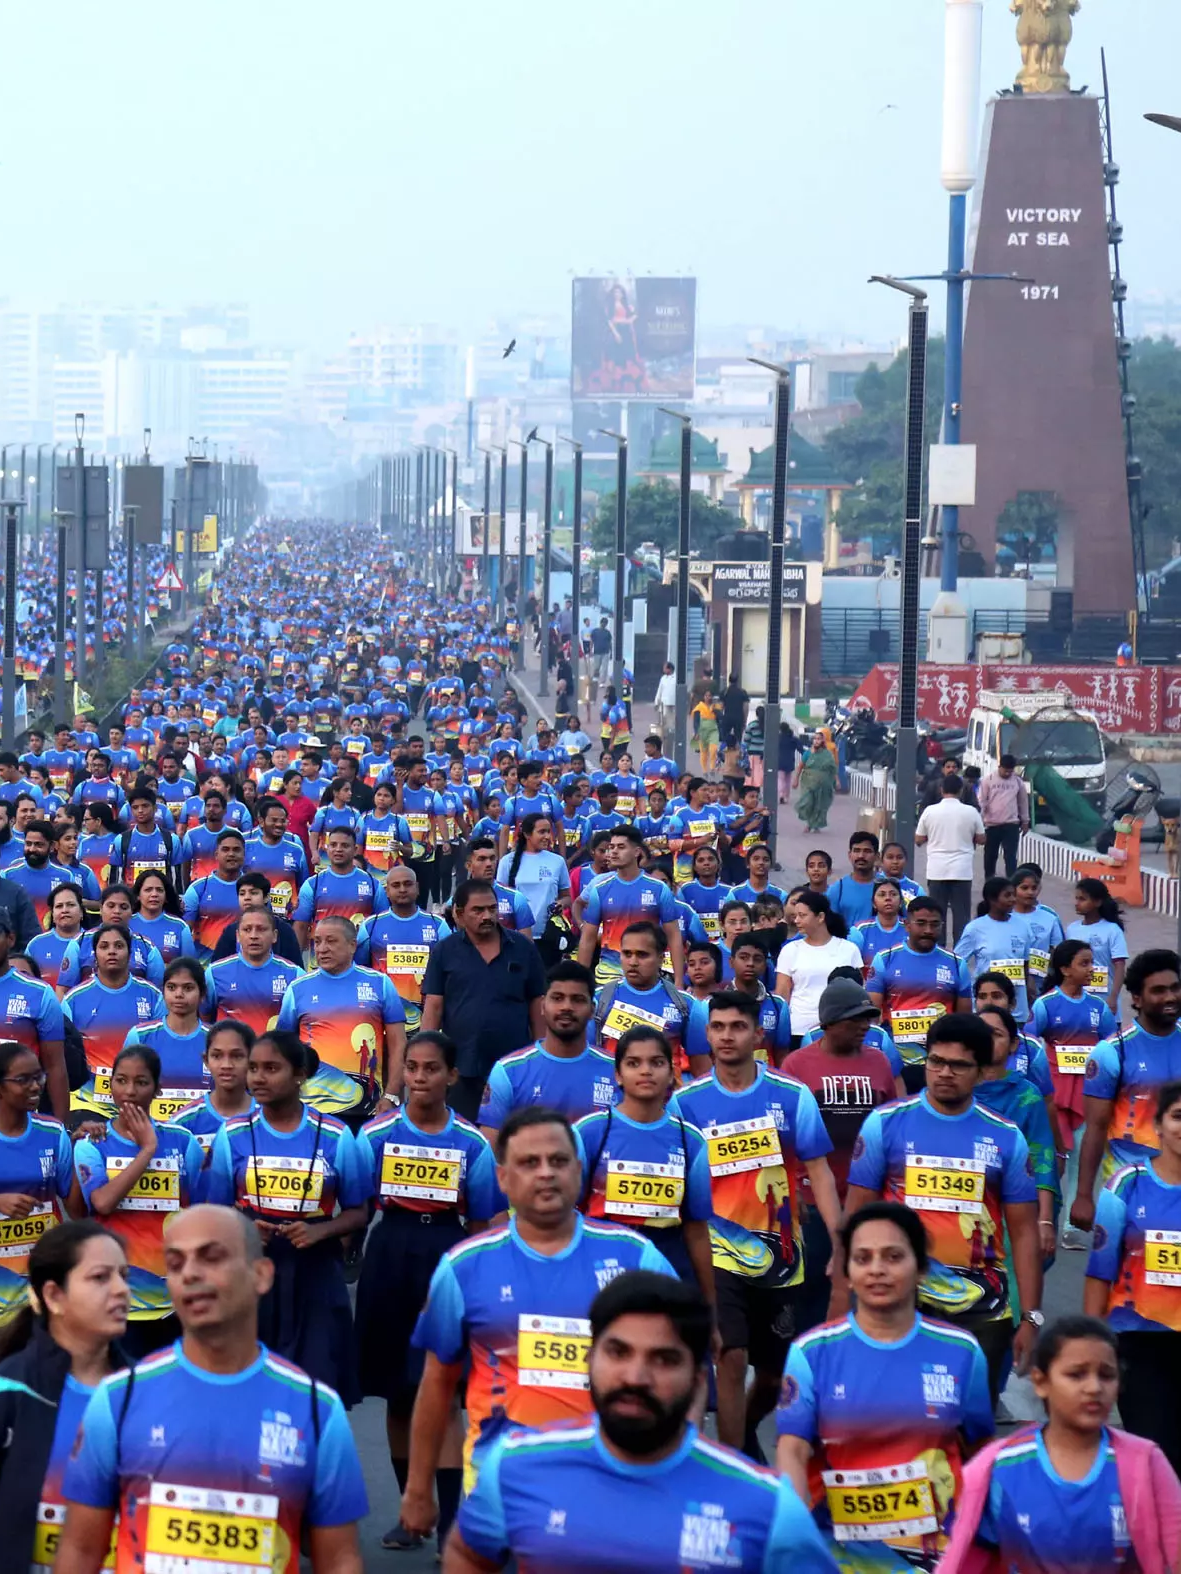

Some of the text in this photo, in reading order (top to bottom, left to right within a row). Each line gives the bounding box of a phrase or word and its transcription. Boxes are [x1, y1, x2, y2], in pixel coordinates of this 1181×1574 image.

[1007, 208, 1081, 222] VICTORY
[1007, 232, 1070, 246] AT SEA
[1021, 286, 1059, 299] 1971
[715, 569, 751, 580] AGARWAL
[393, 954, 424, 965] 53887
[1064, 1055, 1085, 1064] 580
[593, 1083, 614, 1091] VIZAG
[821, 1075, 873, 1105] DEPTH
[593, 1091, 614, 1102] NAVY
[717, 1134, 771, 1157] 56254
[393, 1162, 449, 1181] 57074
[137, 1177, 170, 1192] 061
[256, 1174, 313, 1192] 57066
[618, 1180, 675, 1199] 57076
[917, 1173, 976, 1194] 51349
[533, 1341, 591, 1364] 5587
[843, 1488, 920, 1514] 55874
[167, 1519, 259, 1551] 55383
